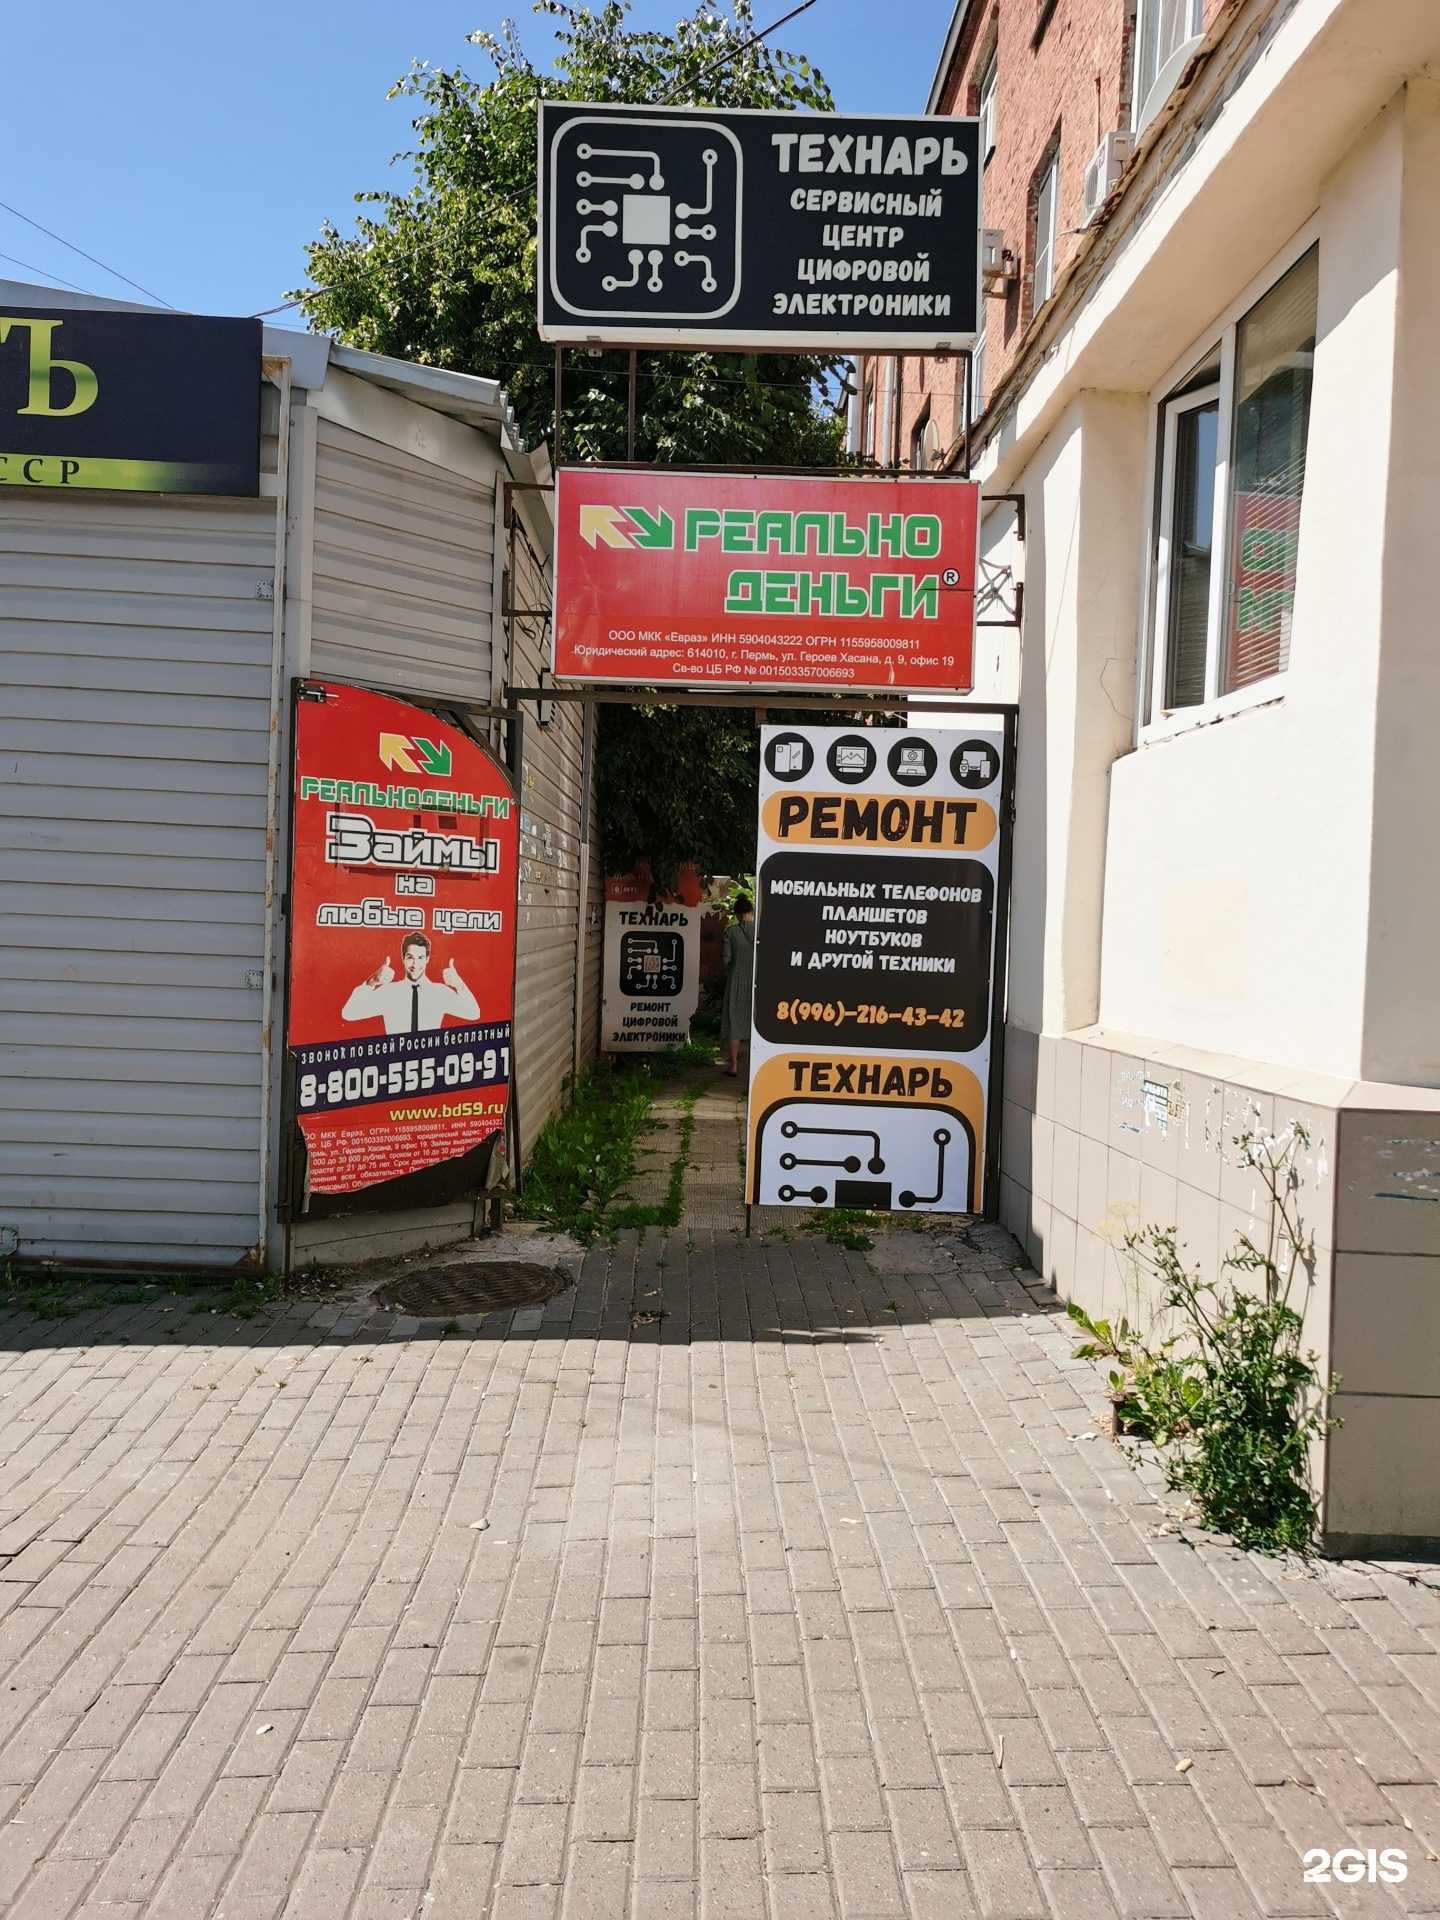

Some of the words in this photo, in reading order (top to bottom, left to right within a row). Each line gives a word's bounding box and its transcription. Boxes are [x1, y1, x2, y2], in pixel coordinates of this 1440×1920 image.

[771, 133, 968, 176] ТЕХНАРЬ
[790, 188, 942, 217] СЕРВИСНЫЙ
[822, 224, 904, 250] ЦЕНТР
[797, 252, 930, 285] ЦИФРОВОЙ
[772, 293, 950, 316] ЭЛЕКТРОНИКИ
[684, 507, 942, 559] РЕАЛЬНО
[724, 568, 940, 620] ДЕНЬГИ
[608, 630, 635, 641] ООО
[639, 631, 661, 642] МКК
[665, 632, 708, 645] «Евраз»
[711, 633, 736, 644] ИНН
[739, 634, 802, 646] 5904043222
[806, 637, 836, 647] ОГРН
[841, 637, 920, 649] 1155958009811
[574, 644, 647, 658] Юридический
[650, 648, 684, 659] адрес:
[687, 648, 728, 661] 614010,
[741, 650, 778, 663] Пермь,
[800, 652, 837, 664] Героев
[840, 653, 881, 665] Хасана,
[911, 655, 939, 667] офис
[942, 656, 954, 666] 19
[672, 663, 703, 673] Св-во
[706, 663, 721, 675] ЦБ
[725, 664, 741, 674] РФ
[744, 665, 757, 675] №
[760, 665, 855, 678] 001503357006693
[778, 796, 977, 844] РЕМОНТ
[325, 810, 500, 874] Займы
[395, 872, 435, 897] на
[770, 879, 876, 899] МОБИЛЬНЫХ
[882, 884, 982, 903] ТЕЛЕФОНОВ
[316, 897, 425, 930] любые
[432, 908, 502, 934] цели
[619, 910, 688, 927] ТЕХНАРЬ
[822, 905, 928, 924] ПЛАНШЕТОВ
[825, 928, 923, 948] НОУТБУКОВ
[791, 951, 802, 967] И
[808, 950, 873, 970] ДРУГОЙ
[879, 955, 955, 973] ТЕХНИКИ
[630, 1002, 671, 1012] РЕМОНТ
[776, 999, 965, 1028] 8(996)-216-43-42
[622, 1015, 678, 1027] ЦИФРОВОЙ
[350, 1043, 364, 1058] по
[367, 1039, 395, 1056] всей
[399, 1036, 441, 1051] России
[444, 1024, 510, 1046] бесплатный
[612, 1031, 686, 1043] ЭЛЕКТРОНИКИ
[300, 1047, 510, 1108] 8-800-555-09-91
[788, 1060, 953, 1098] ТЕХНАРЬ
[389, 1101, 504, 1121] www.bd59.ru
